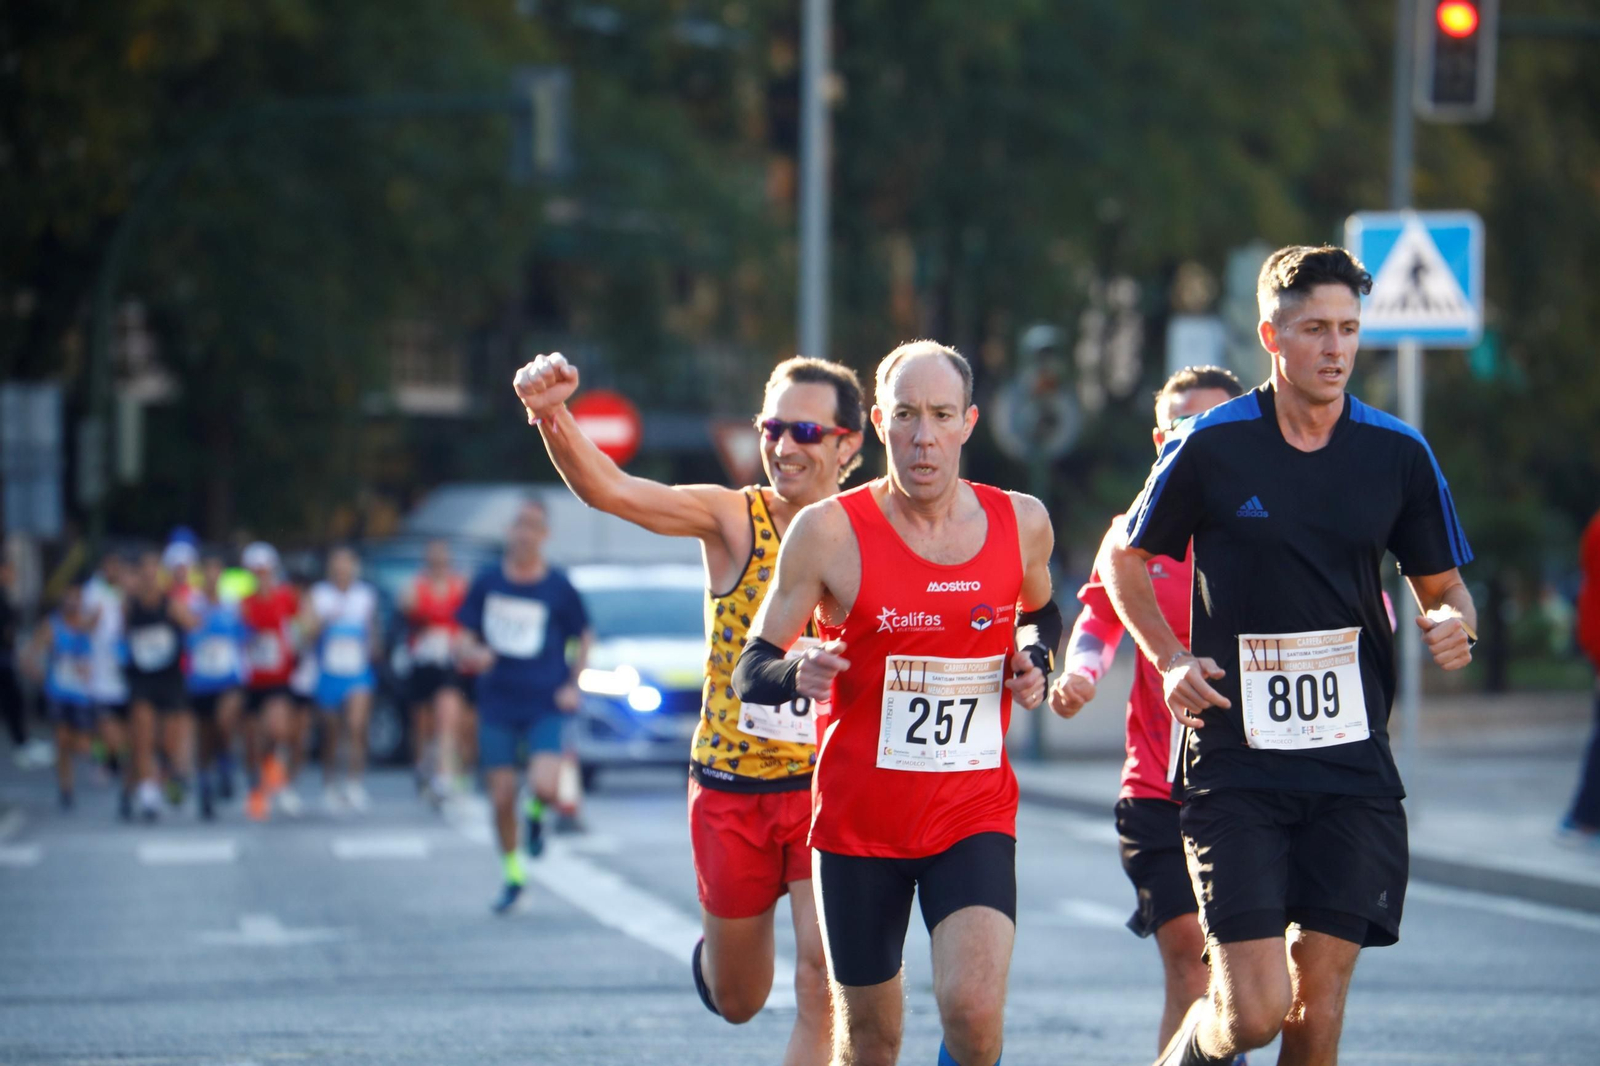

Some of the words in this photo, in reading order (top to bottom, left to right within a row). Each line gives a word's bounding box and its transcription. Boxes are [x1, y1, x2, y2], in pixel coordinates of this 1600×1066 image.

[1236, 509, 1269, 518] adidas
[892, 612, 941, 627] califas
[1297, 637, 1322, 646] CARRERA
[1245, 639, 1283, 671] XLI
[943, 664, 967, 672] CARRERA
[968, 662, 990, 671] POPULAR
[1285, 661, 1314, 671] MEMORIAL
[890, 660, 928, 693] XLI
[927, 686, 955, 695] MEMORIAL
[1268, 671, 1340, 723] 809
[906, 697, 978, 745] 257
